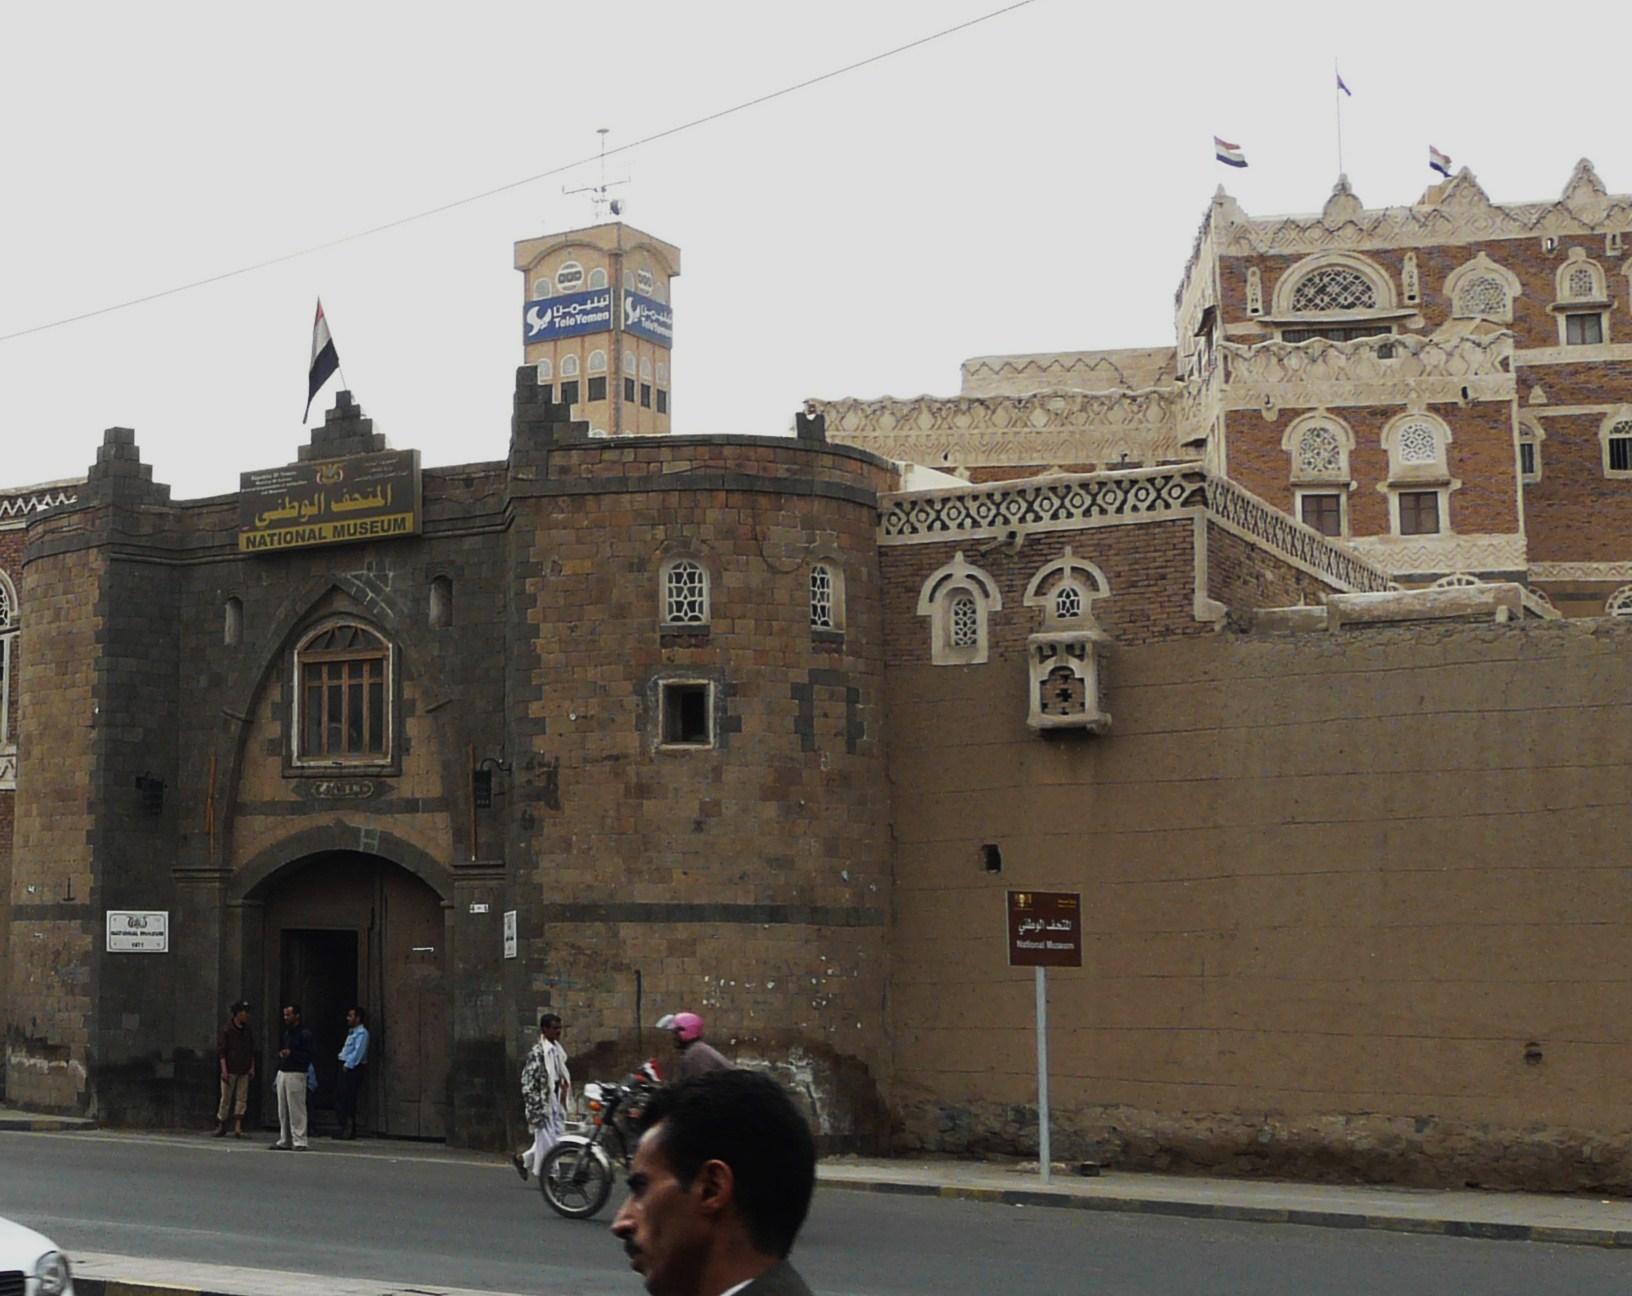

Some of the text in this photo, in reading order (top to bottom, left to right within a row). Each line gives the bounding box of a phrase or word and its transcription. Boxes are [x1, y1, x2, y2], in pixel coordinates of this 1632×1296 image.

[554, 311, 609, 328] TeleYemen
[330, 482, 392, 513] المتحف
[246, 516, 406, 550] NATIONAL MUSEUM
